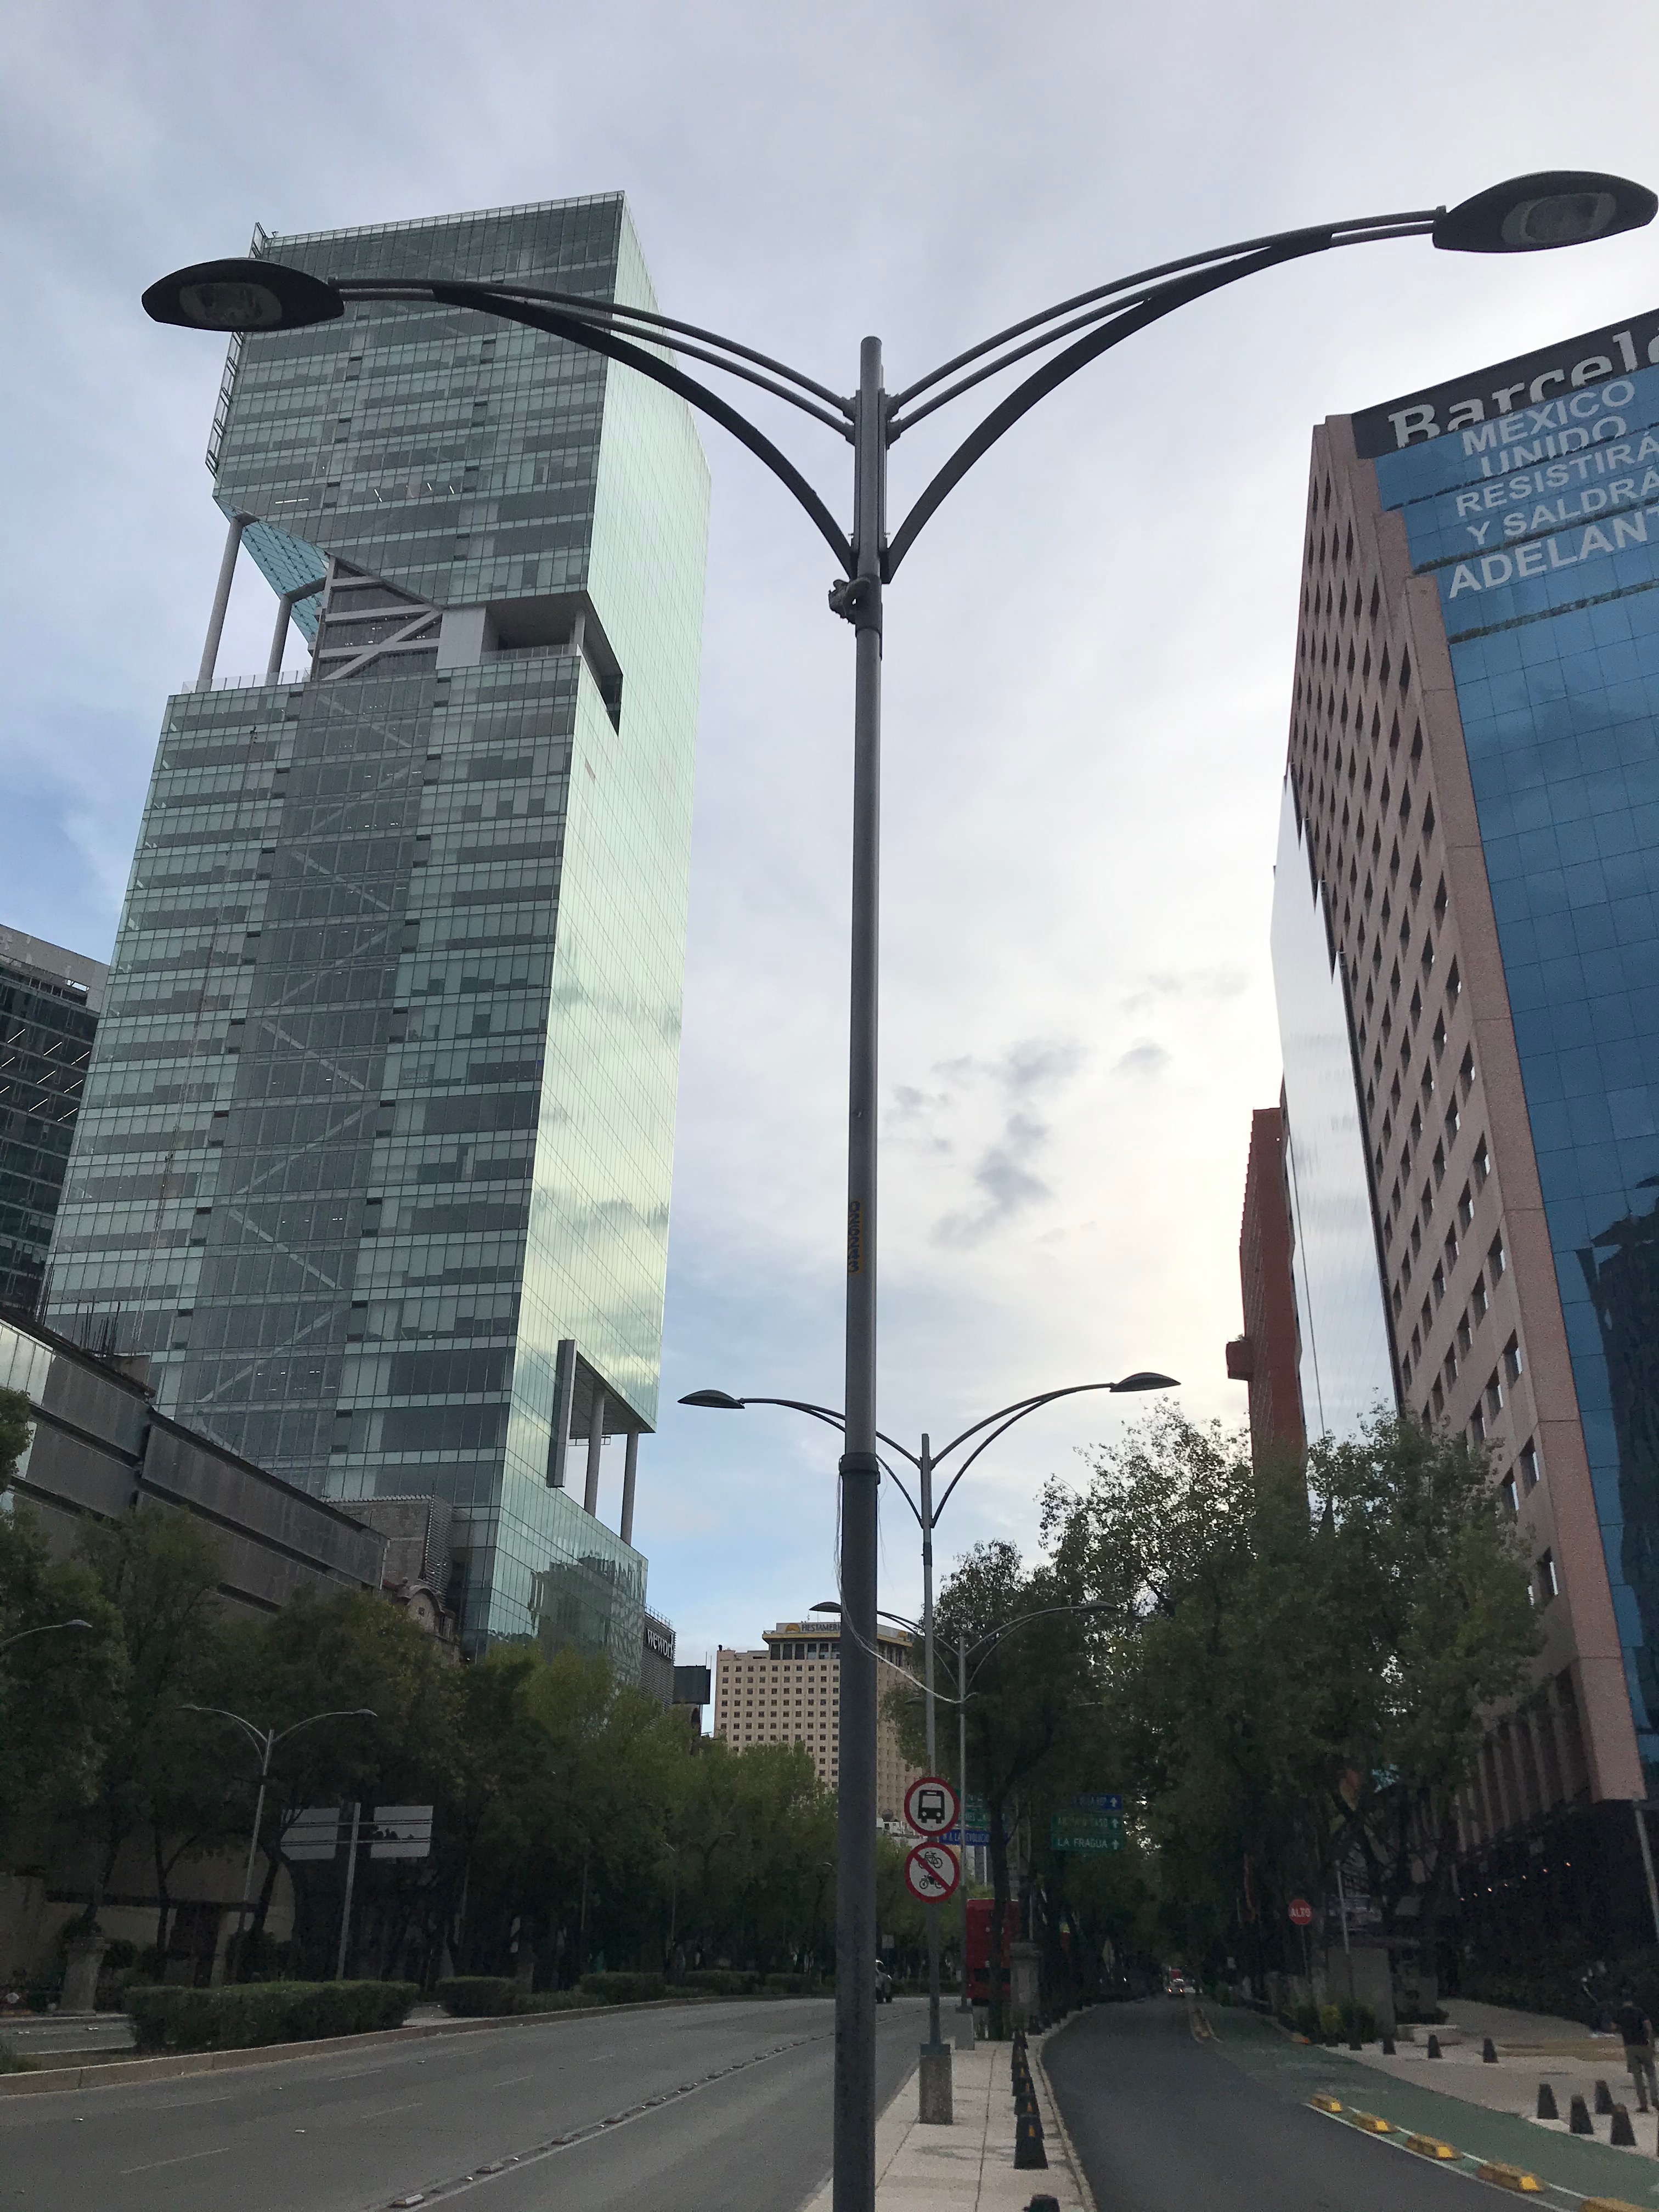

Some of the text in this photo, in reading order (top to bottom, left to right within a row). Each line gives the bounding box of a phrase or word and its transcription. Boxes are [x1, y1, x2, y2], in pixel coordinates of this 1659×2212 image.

[1455, 431, 1659, 517] RESISTIRÁ
[1481, 416, 1627, 477] UNIDO
[1466, 465, 1659, 545] Y SALDRÁ
[1058, 1838, 1108, 1849] LA FRAGUA
